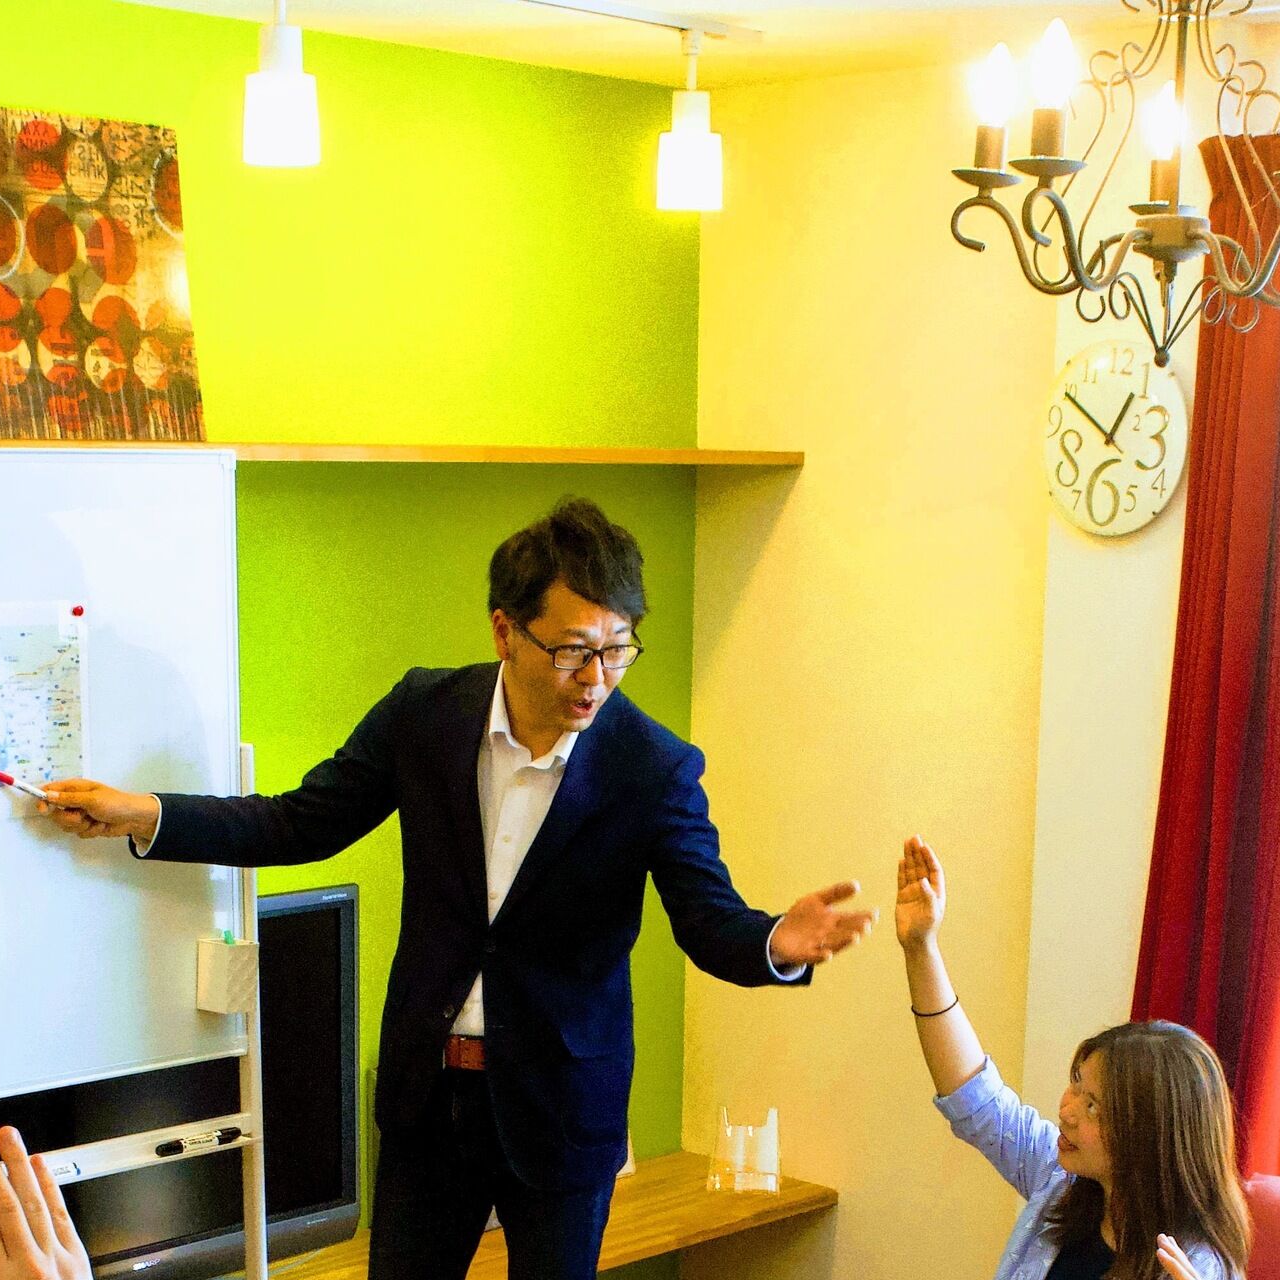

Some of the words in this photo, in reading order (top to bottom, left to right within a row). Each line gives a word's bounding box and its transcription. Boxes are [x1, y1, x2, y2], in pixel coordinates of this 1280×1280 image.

[1082, 358, 1099, 384] 11
[1109, 346, 1135, 376] 12
[1138, 362, 1151, 399] 1
[1047, 404, 1063, 439] 9
[1132, 414, 1141, 432] 2
[1135, 404, 1171, 471] 3
[1055, 428, 1083, 487] 8
[1086, 458, 1122, 527] 6
[1123, 484, 1139, 513] 5
[1151, 468, 1167, 499] 4
[1071, 488, 1083, 511] 7
